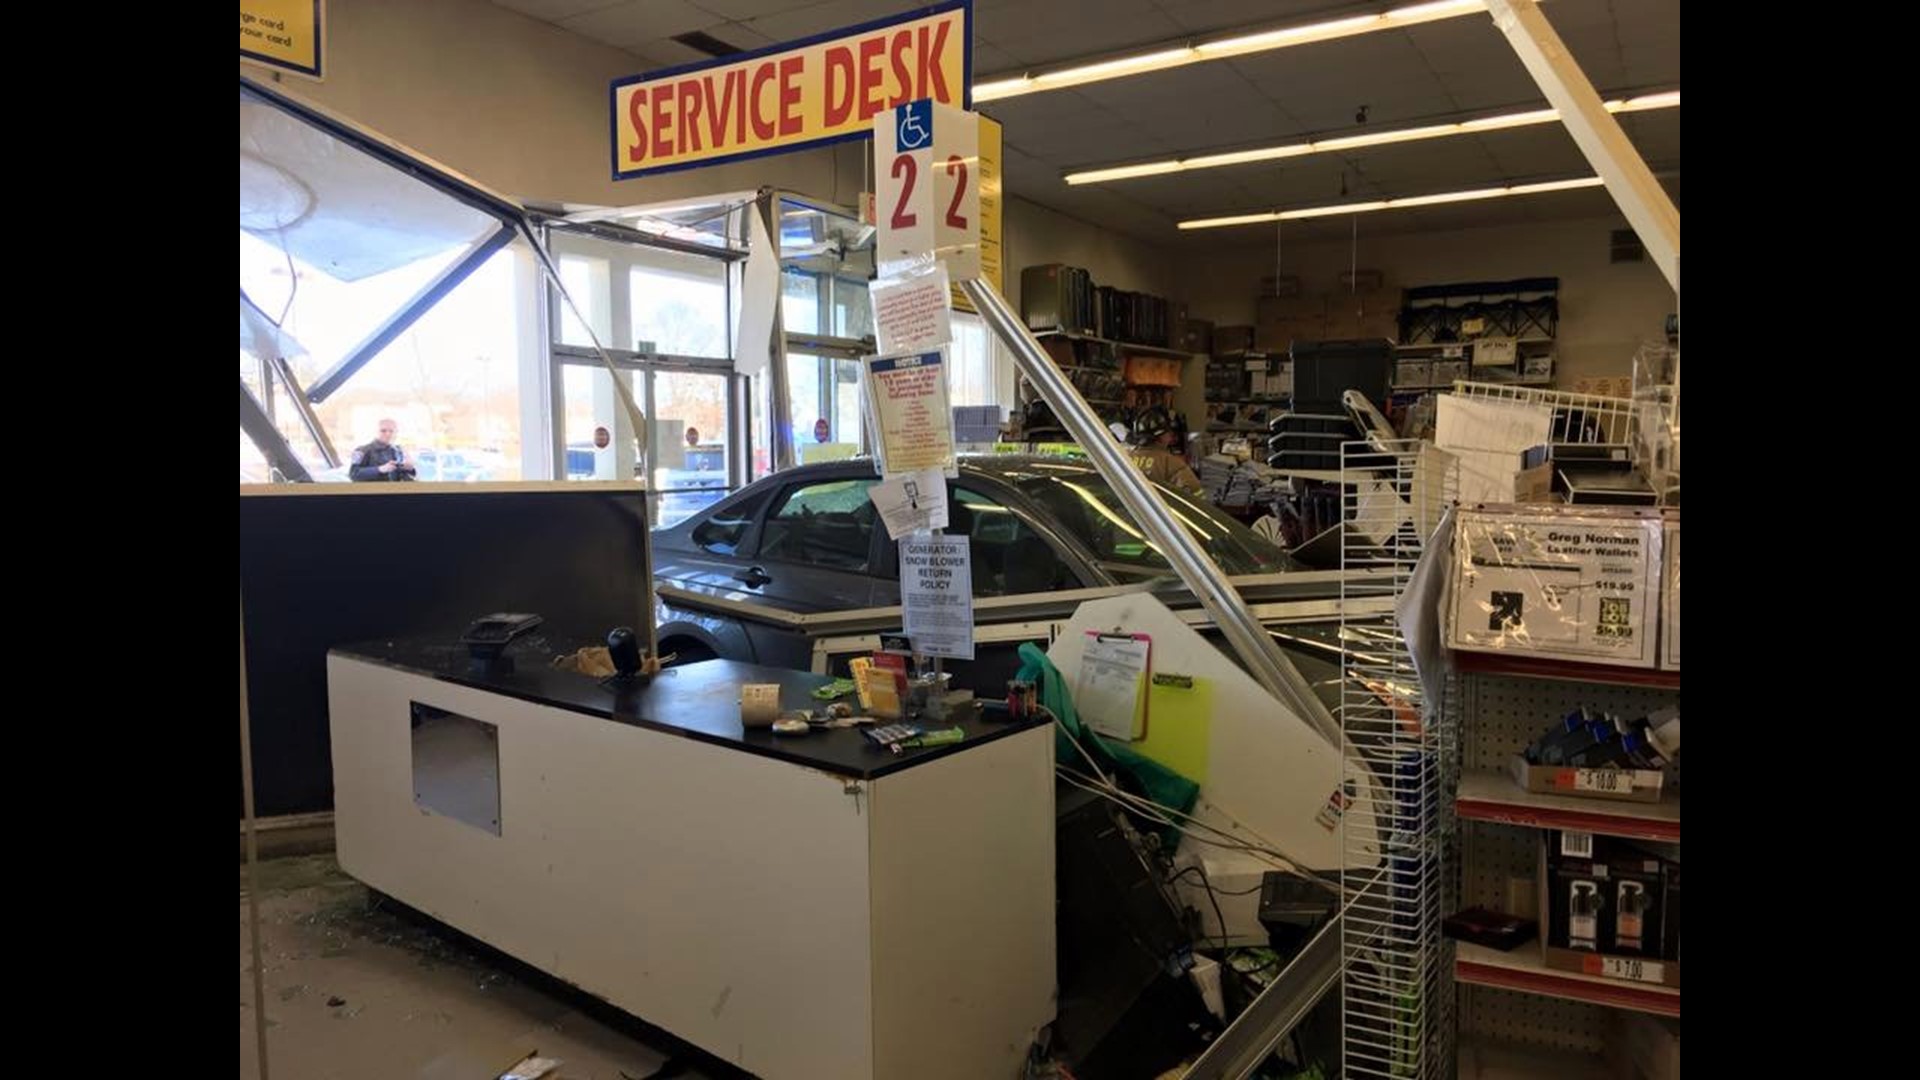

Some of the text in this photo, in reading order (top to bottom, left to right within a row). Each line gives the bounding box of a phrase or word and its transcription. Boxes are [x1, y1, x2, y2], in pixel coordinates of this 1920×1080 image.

[259, 18, 284, 31] card
[267, 35, 292, 47] card
[629, 20, 951, 163] SERVICE DESK
[891, 154, 917, 230] 2
[945, 154, 968, 230] 2
[1548, 532, 1640, 545] Greg Norman
[1595, 546, 1640, 557] Wallets
[905, 556, 965, 567] SNOW BLOWER
[918, 568, 952, 578] RETURN
[920, 580, 951, 590] POLICY
[1595, 580, 1634, 591] $19.99
